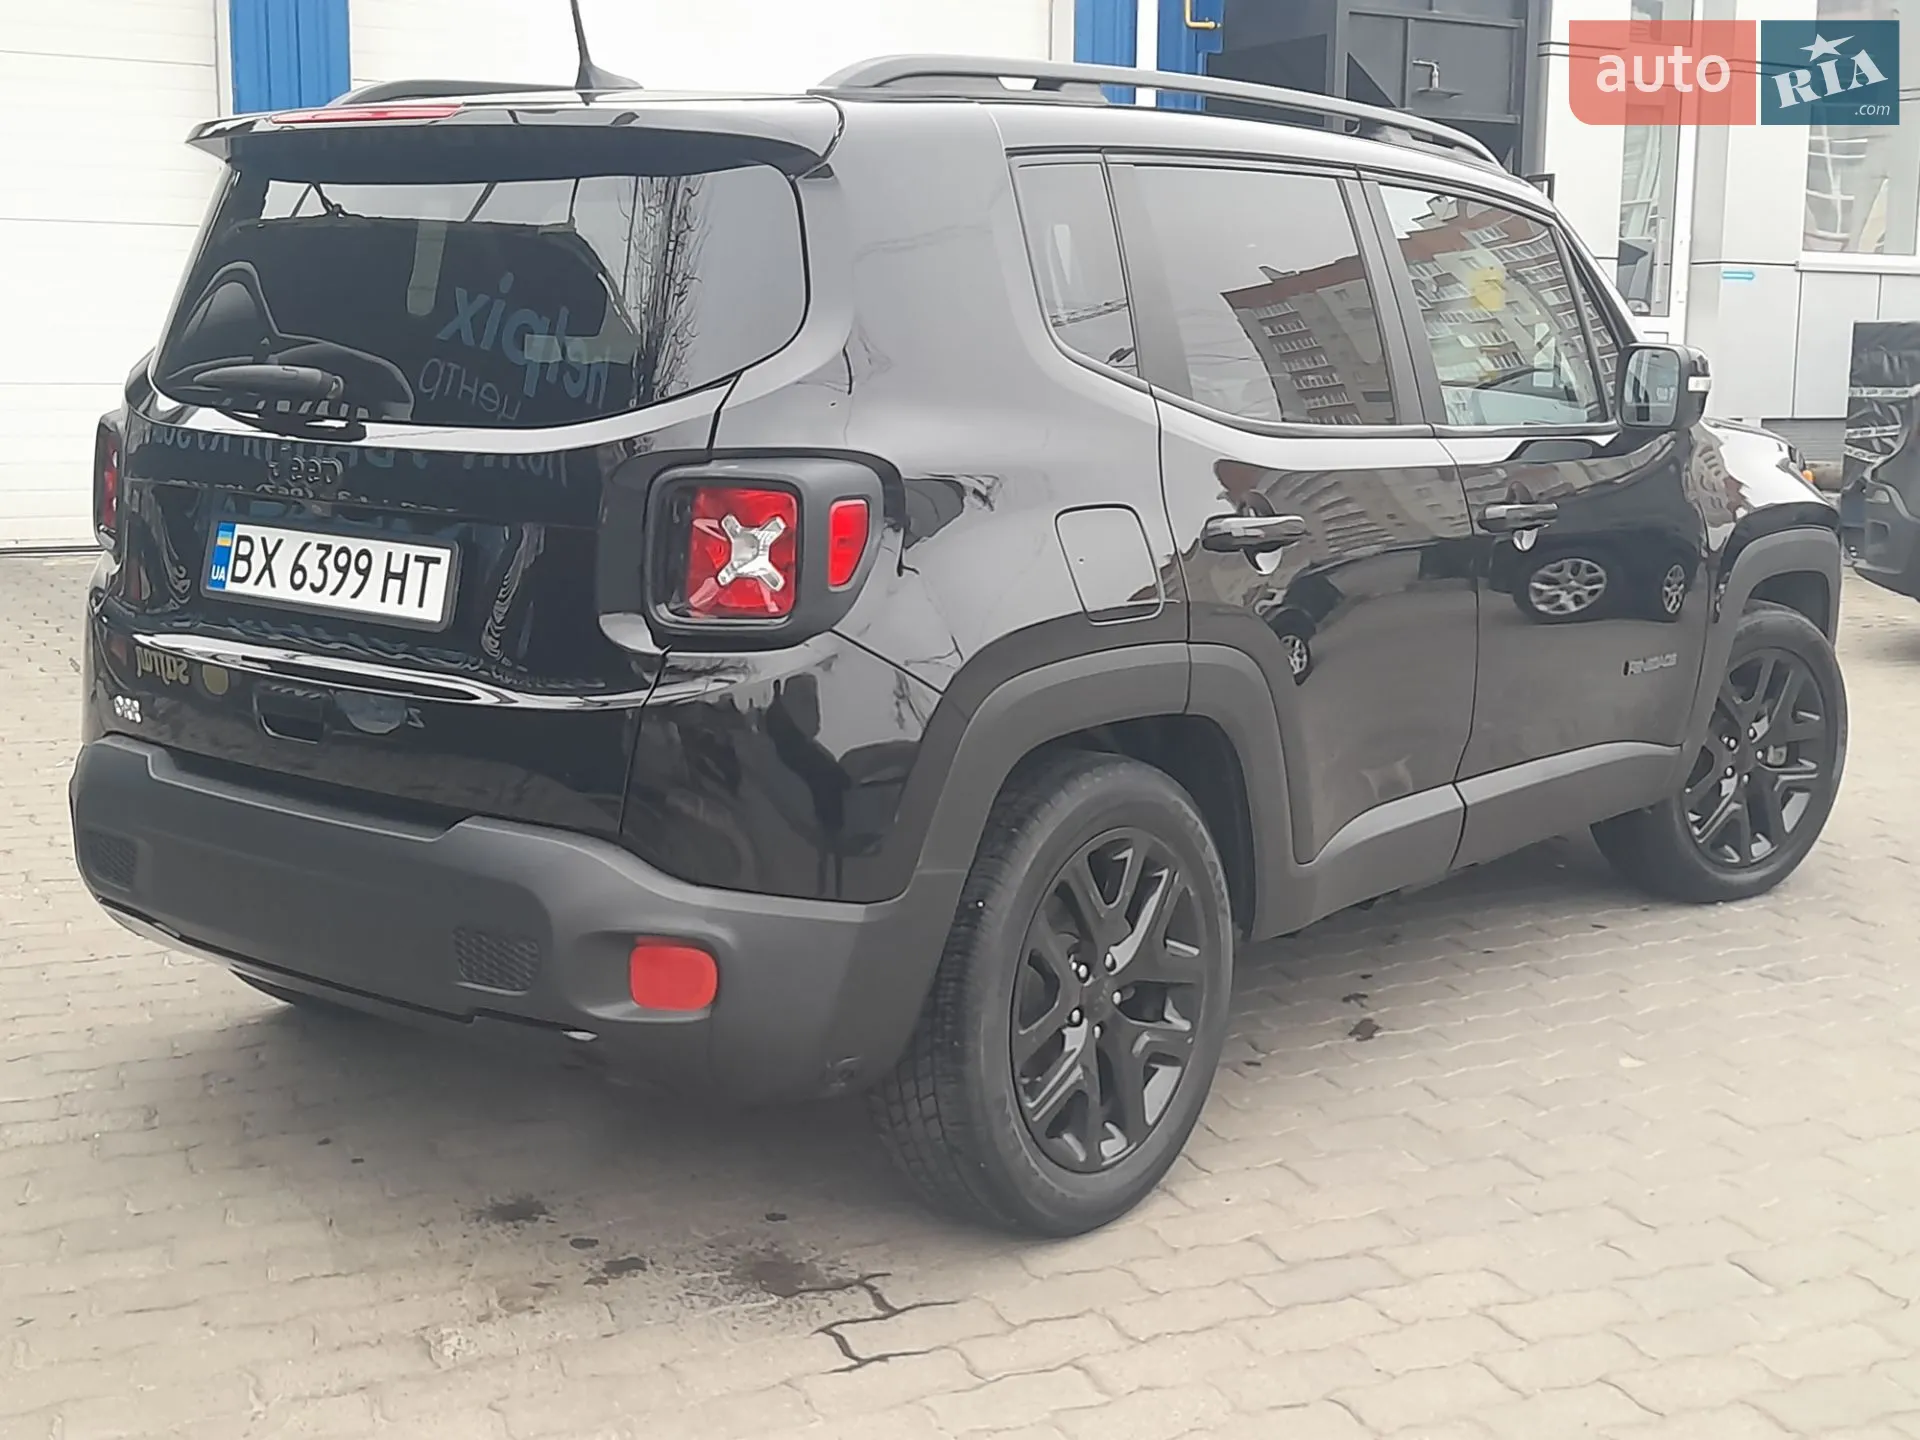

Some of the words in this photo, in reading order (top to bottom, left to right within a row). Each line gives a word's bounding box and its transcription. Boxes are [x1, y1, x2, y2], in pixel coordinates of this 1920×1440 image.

[211, 564, 226, 582] UA
[230, 534, 284, 589] BX
[289, 541, 373, 600] 6399
[380, 551, 442, 609] HT
